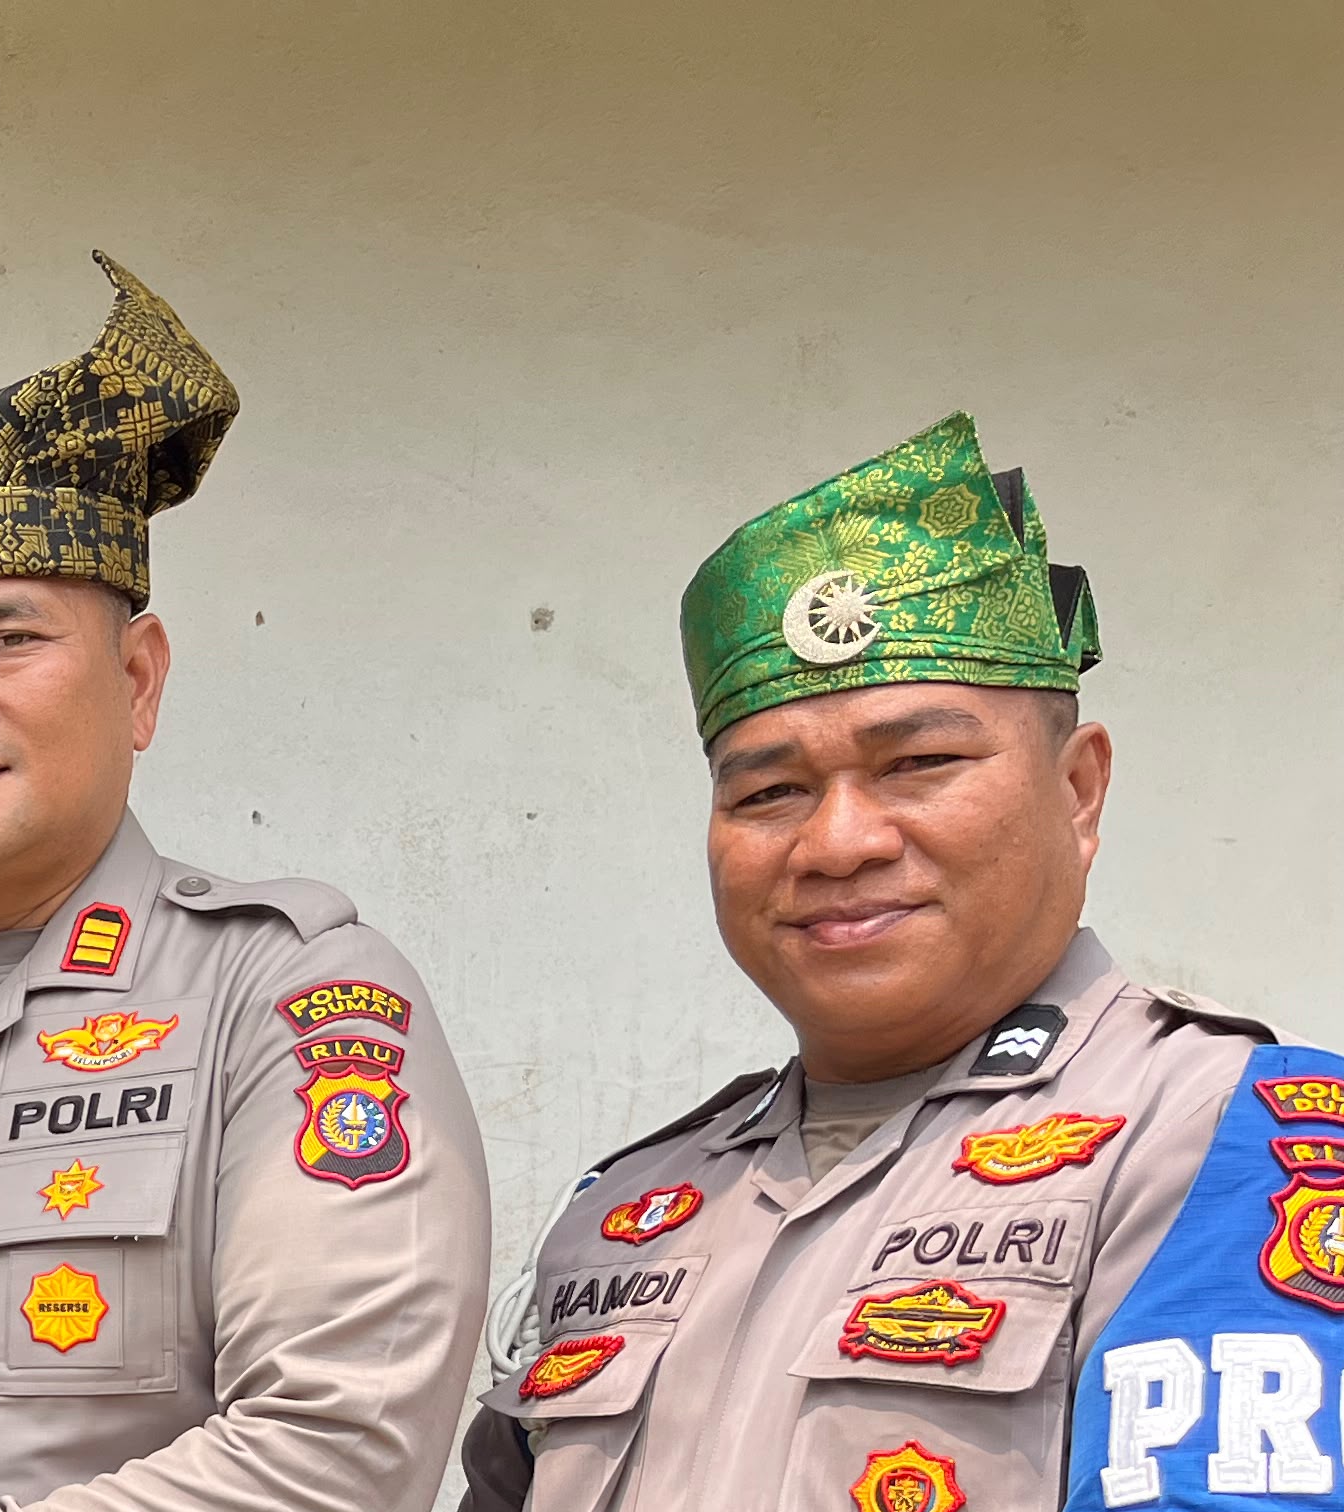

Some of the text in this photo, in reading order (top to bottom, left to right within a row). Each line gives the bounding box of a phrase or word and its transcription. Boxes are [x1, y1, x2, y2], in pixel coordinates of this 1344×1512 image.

[288, 985, 403, 1018] POLRES
[308, 999, 393, 1021] DUMAI
[310, 1040, 392, 1063] RIAU
[9, 1083, 175, 1141] POLRI
[870, 1216, 1067, 1273] POLRI
[39, 1302, 89, 1313] RESERSE
[550, 1267, 688, 1325] HAMDI
[1100, 1333, 1344, 1508] PR
